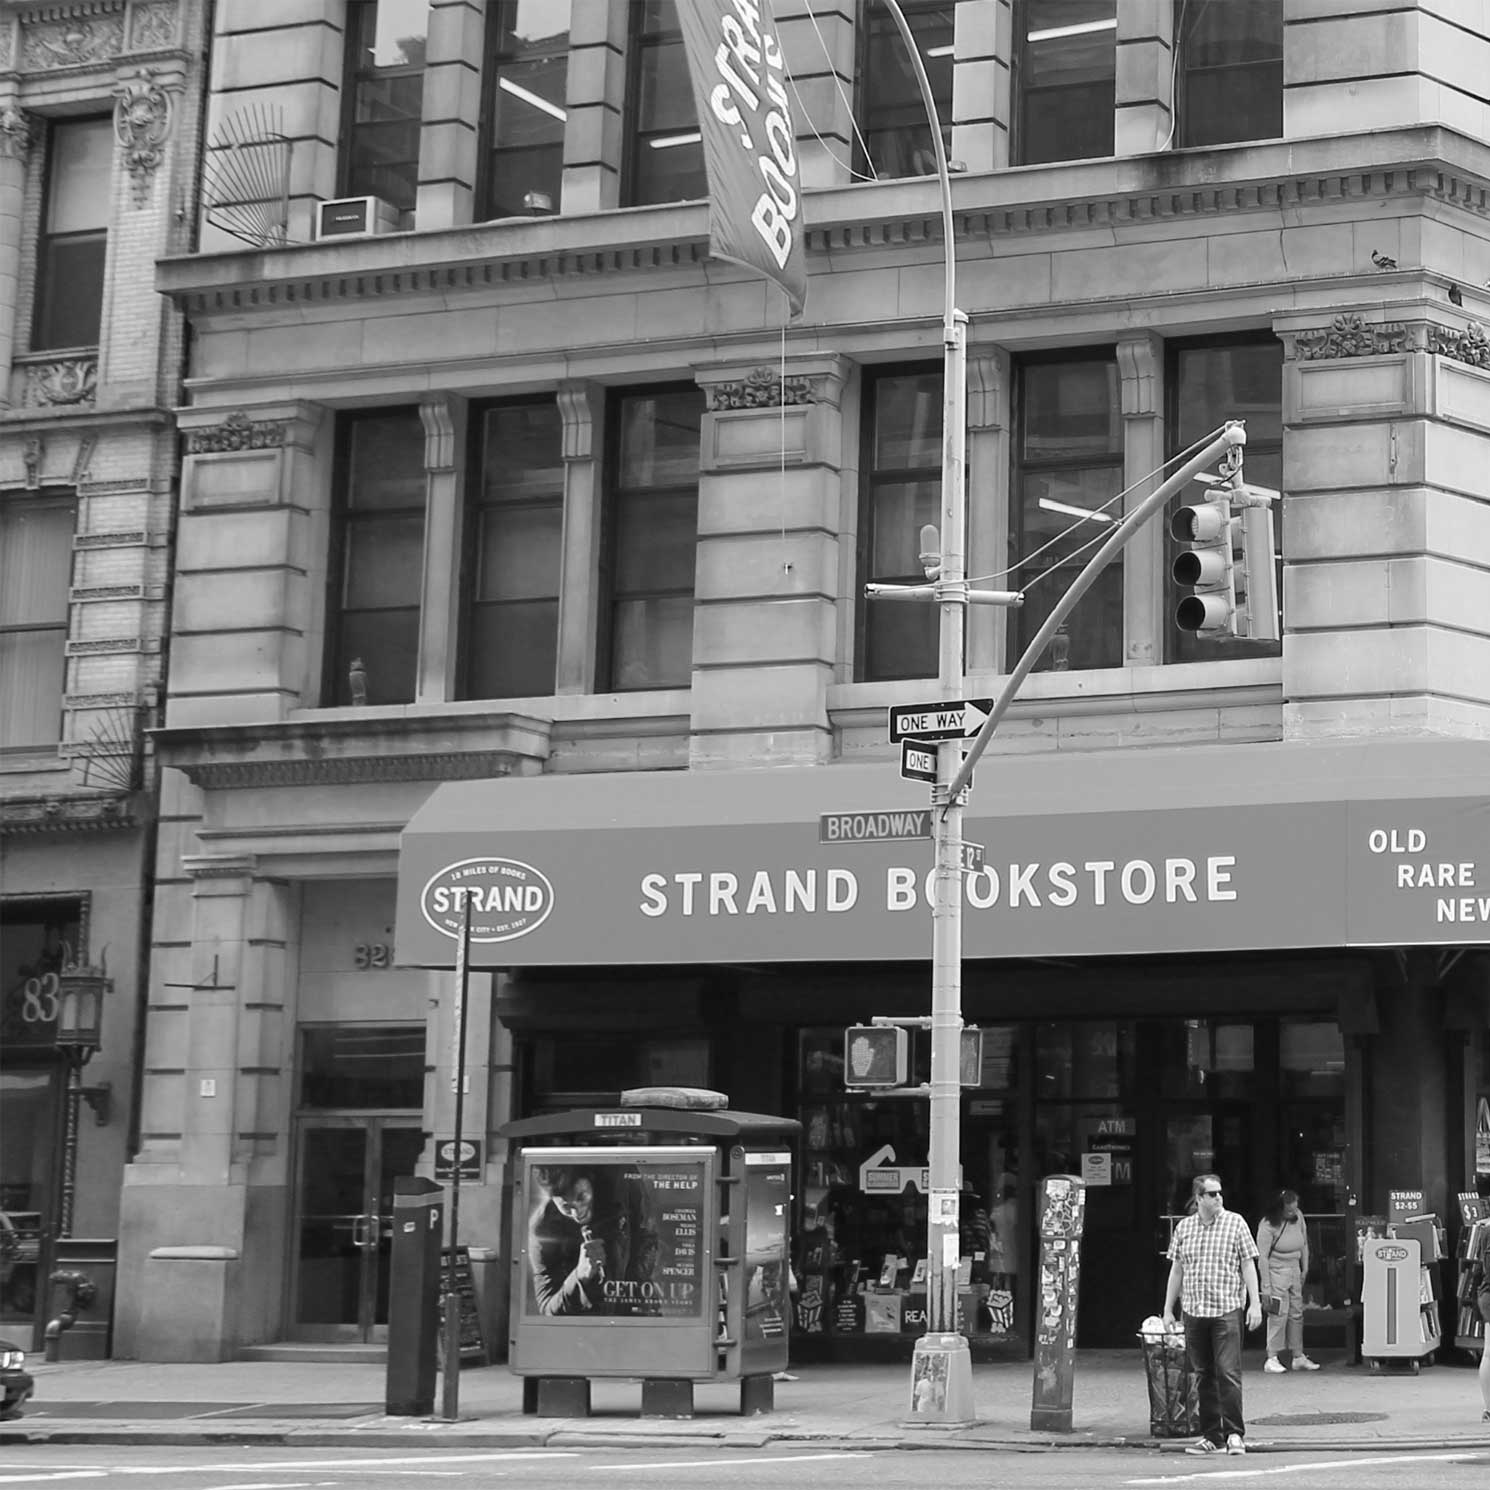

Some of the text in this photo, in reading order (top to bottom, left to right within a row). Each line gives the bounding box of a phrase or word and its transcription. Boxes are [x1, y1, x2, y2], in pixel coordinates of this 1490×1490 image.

[901, 712, 966, 731] ONE WAY
[910, 753, 929, 770] ONE
[827, 813, 925, 839] BROADWAY
[1369, 829, 1426, 853] OLD
[463, 866, 487, 876] MILES
[488, 866, 500, 874] OF
[501, 866, 526, 881] BOOKS
[1397, 863, 1475, 888] RARE
[433, 886, 543, 912] STRAND
[640, 868, 858, 917] STRAND
[601, 1115, 636, 1125] TITAN
[1098, 1120, 1125, 1133] ATM
[653, 1181, 698, 1190] THE HELP
[1391, 1192, 1422, 1200] STRAND
[1458, 1192, 1479, 1200] STRAND
[1395, 1201, 1417, 1210] $2-$5
[430, 1209, 439, 1229] P
[603, 1280, 694, 1299] GET ON UP
